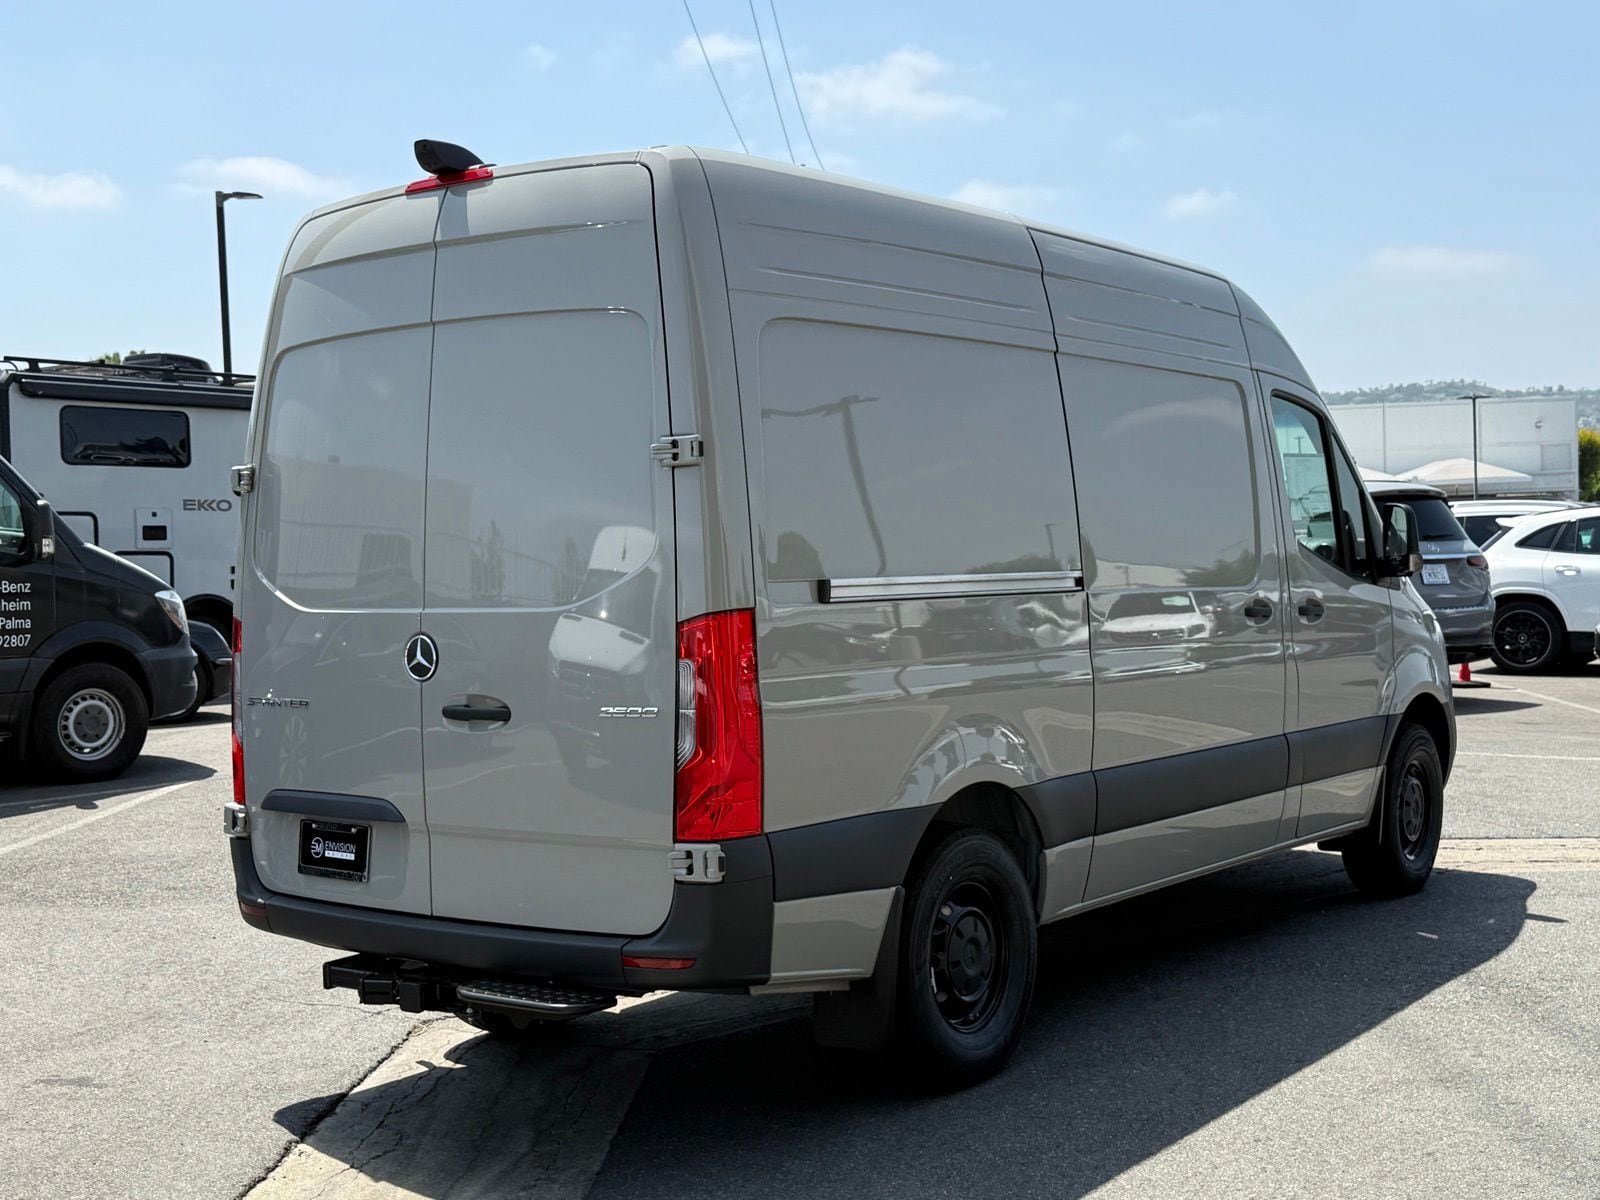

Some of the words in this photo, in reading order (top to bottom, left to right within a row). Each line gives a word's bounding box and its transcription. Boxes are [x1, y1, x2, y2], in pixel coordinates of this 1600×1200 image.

[183, 499, 232, 512] EKKO
[1, 598, 31, 611] heim
[0, 617, 31, 629] Palma
[599, 706, 658, 718] 2500
[325, 841, 356, 853] ENVISION
